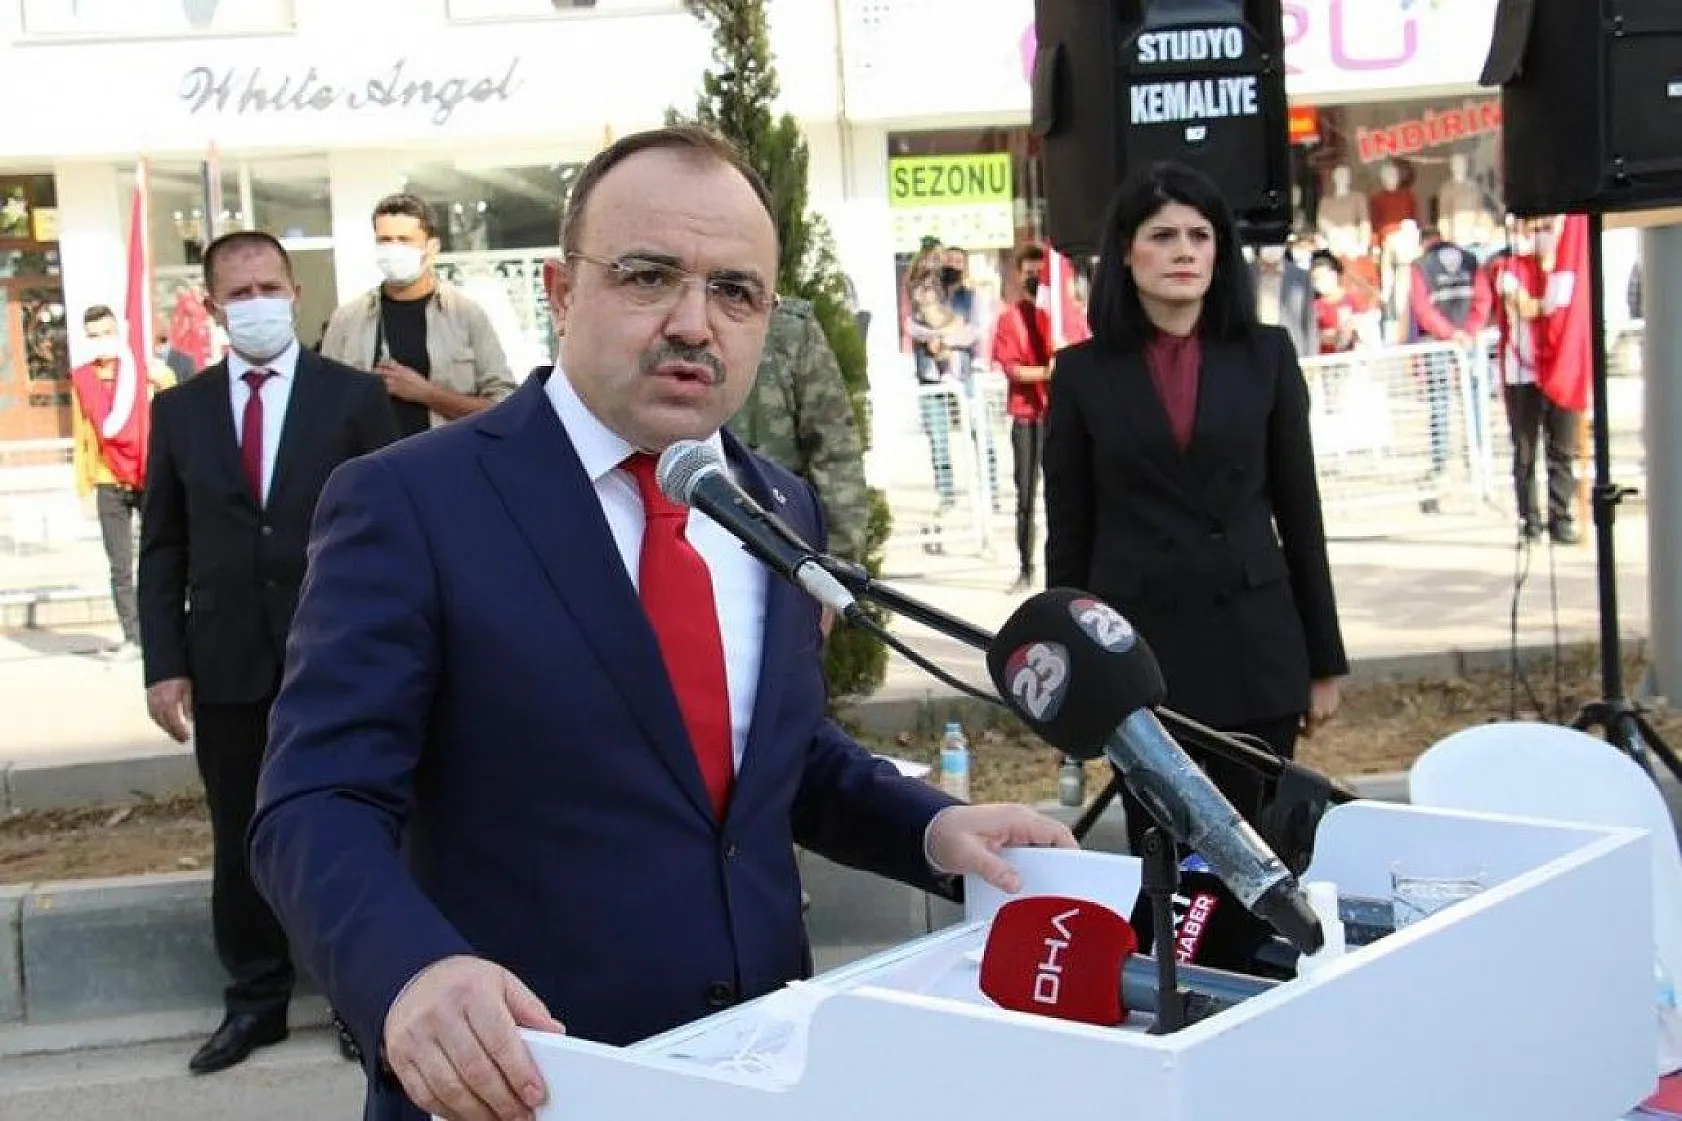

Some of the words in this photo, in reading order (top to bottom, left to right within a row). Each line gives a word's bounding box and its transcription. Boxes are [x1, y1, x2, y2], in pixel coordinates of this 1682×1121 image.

[1137, 27, 1244, 64] STUDYO
[179, 66, 340, 114] White
[347, 55, 520, 126] Angel
[894, 161, 1007, 199] SEZONU
[1078, 601, 1134, 648] 23
[1012, 643, 1067, 720] 23
[1033, 907, 1081, 1005] DHA
